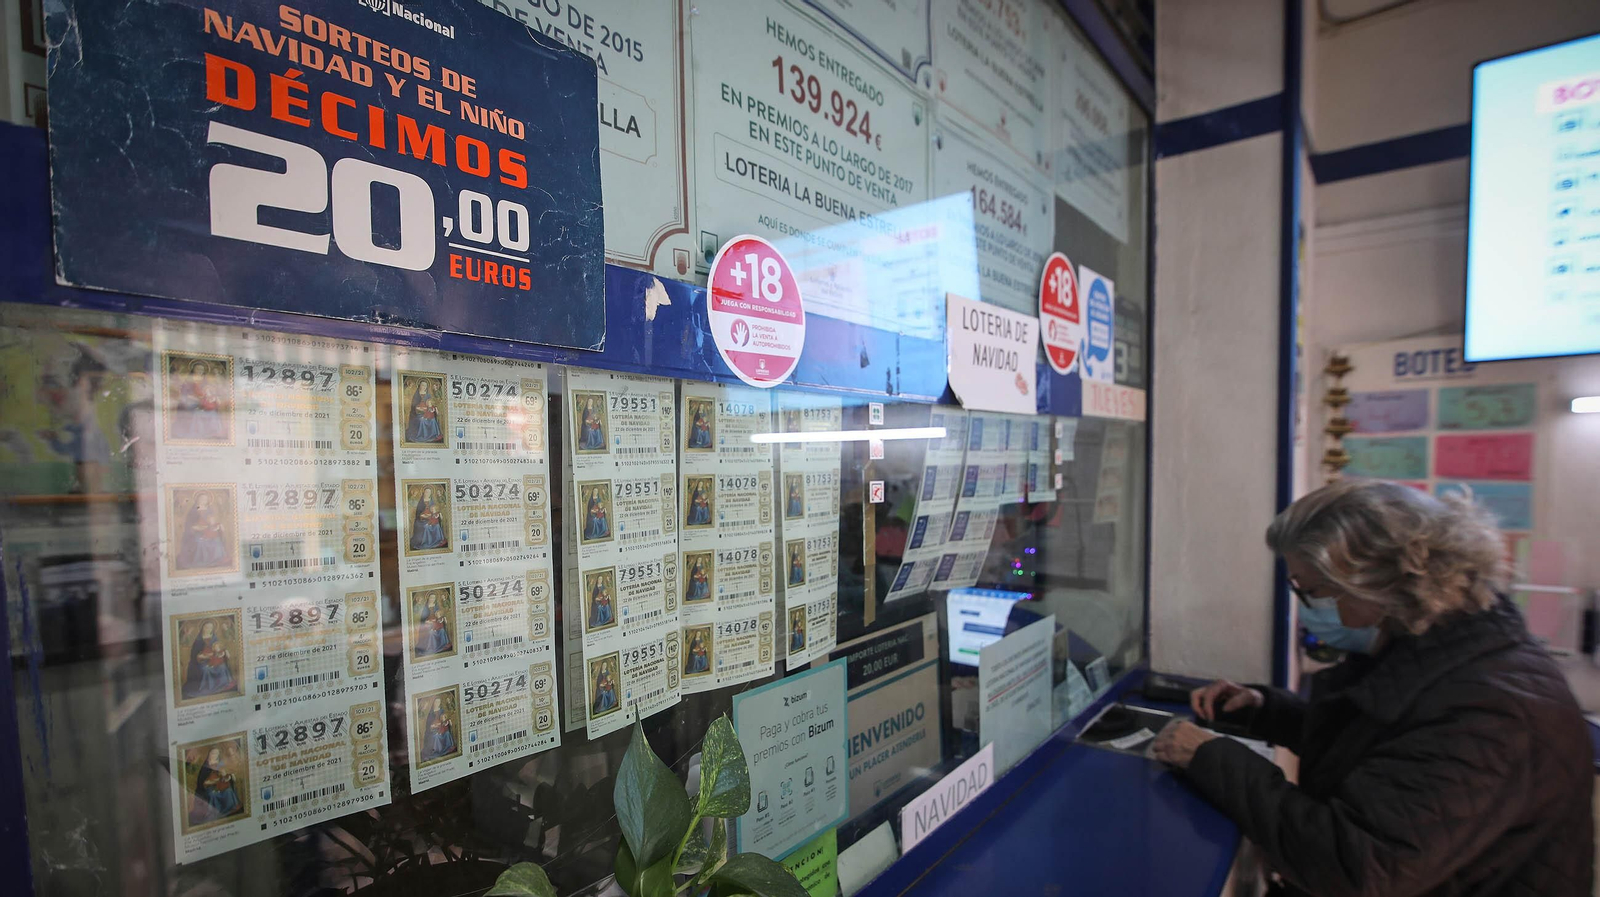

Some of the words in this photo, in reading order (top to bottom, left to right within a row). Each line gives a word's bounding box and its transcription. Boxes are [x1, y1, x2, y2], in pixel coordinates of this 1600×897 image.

[392, 1, 455, 39] Nacional
[568, 4, 595, 39] DE
[600, 25, 644, 62] 2015
[279, 4, 431, 81] SORTEOS
[441, 67, 477, 98] DE
[765, 16, 816, 62] HEMOS
[818, 51, 884, 107] ENTREGADO
[203, 8, 374, 89] NAVIDAD
[390, 78, 406, 98] Y
[417, 85, 452, 117] EL
[460, 104, 526, 141] NIÑO
[772, 55, 872, 145] 139.924
[204, 52, 529, 190] DÉCIMOS
[721, 83, 742, 108] EN
[747, 96, 809, 142] PREMIOS
[811, 131, 820, 148] A
[823, 135, 838, 157] LO
[841, 145, 876, 176] LARGO
[878, 166, 891, 186] DE
[749, 121, 770, 144] EN
[775, 132, 802, 161] ESTE
[805, 152, 846, 181] PUNTO
[848, 171, 862, 191] DE
[864, 180, 898, 207] VENTA
[725, 151, 791, 196] LOTERIA
[794, 182, 811, 205] LA
[815, 191, 857, 222] BUENA
[971, 184, 1022, 232] 164.584
[449, 254, 532, 291] EUROS
[730, 253, 784, 303] +18
[1049, 265, 1074, 308] +18
[720, 299, 738, 308] JUEGA
[740, 302, 751, 311] CON
[752, 304, 797, 318] RESPONSABILIDAD
[962, 306, 1013, 342] LOTERIA
[1015, 320, 1028, 345] DE
[972, 342, 1019, 373] NAVIDAD
[242, 365, 334, 388] 12897
[452, 381, 517, 399] 50274
[611, 397, 656, 410] 79551
[719, 403, 754, 415] 14078
[804, 408, 831, 418] 81753
[350, 429, 362, 440] 20
[528, 434, 538, 442] 20
[615, 480, 658, 496] 79551
[719, 477, 757, 489] 14078
[806, 473, 832, 484] 81753
[245, 488, 337, 509] 12897
[455, 484, 520, 499] 50274
[457, 503, 487, 512] LOTERÍA
[480, 509, 510, 517] NAVIDAD
[531, 529, 541, 537] 20
[806, 536, 831, 550] 81753
[352, 543, 366, 553] 20
[718, 549, 757, 563] 14078
[619, 562, 661, 581] 79551
[459, 579, 523, 602] 50274
[251, 603, 340, 631] 12897
[484, 607, 514, 617] NAVIDAD
[808, 599, 830, 615] 81753
[534, 622, 544, 631] 20
[717, 619, 757, 636] 14078
[277, 648, 311, 659] diciembre
[322, 644, 338, 652] 2021
[357, 655, 370, 665] 20
[623, 641, 663, 665] 79551
[863, 660, 883, 676] 20,00
[884, 653, 899, 669] EUR
[464, 675, 527, 703] 50274
[791, 691, 807, 704] bizum
[466, 703, 495, 715] LOTERÍA
[488, 703, 518, 716] NAVIDAD
[538, 714, 548, 724] 20
[760, 722, 782, 741] Paga
[784, 718, 790, 733] y
[792, 708, 814, 727] cobra
[816, 703, 829, 716] tus
[256, 716, 345, 752] 12897
[753, 739, 789, 767] premios
[791, 730, 806, 746] con
[808, 719, 834, 739] Bizum
[255, 751, 298, 768] LOTERÍA
[300, 740, 347, 756] NACIONAL
[271, 762, 287, 772] DE
[288, 751, 332, 768] NAVIDAD
[283, 764, 316, 778] diciembre
[327, 758, 342, 766] 2021
[362, 765, 375, 776] 20
[849, 763, 861, 780] UN
[863, 749, 889, 775] PLACER
[914, 762, 988, 840] NAVIDAD
